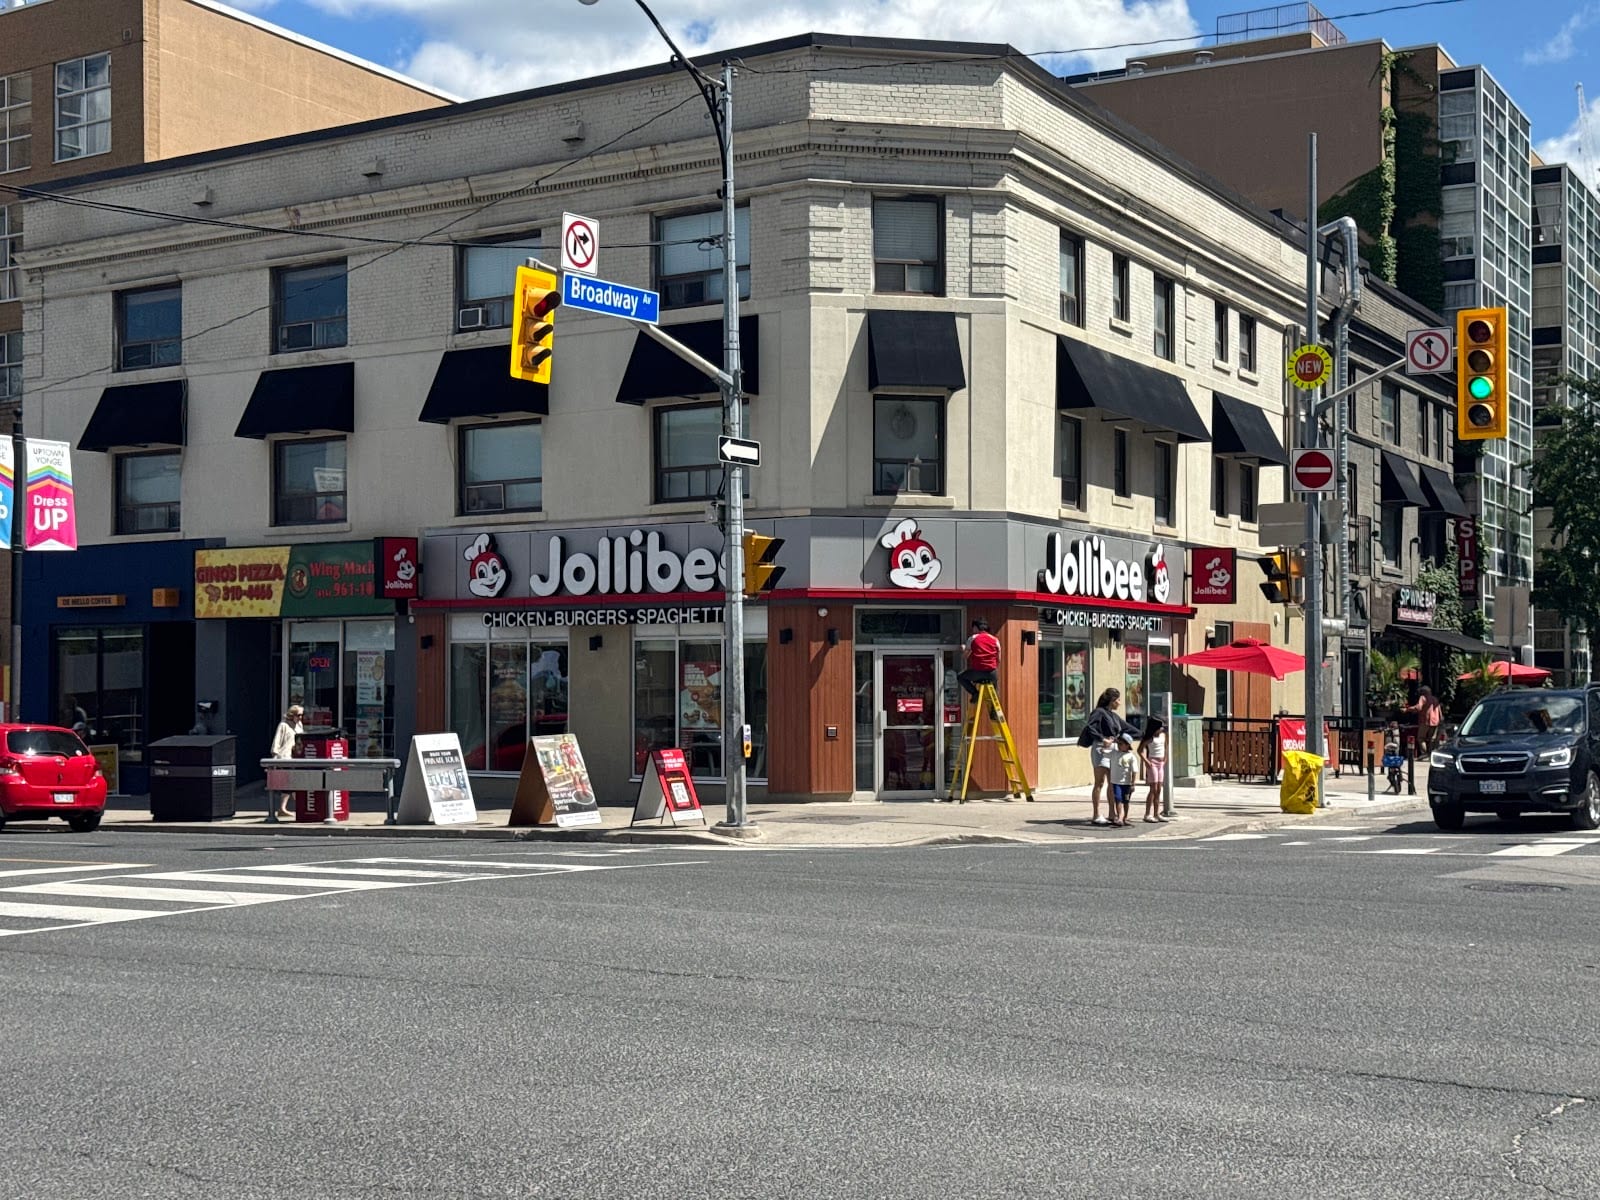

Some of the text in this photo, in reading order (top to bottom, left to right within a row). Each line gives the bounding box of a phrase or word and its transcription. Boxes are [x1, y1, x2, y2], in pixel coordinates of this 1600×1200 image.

[571, 277, 652, 315] Broadway Av
[1296, 360, 1322, 375] NEW
[33, 448, 64, 457] UPTOWN
[36, 457, 62, 466] YONGE
[33, 495, 68, 506] Dress
[34, 507, 68, 531] UP
[1459, 520, 1474, 577] SIP
[239, 563, 284, 582] PIZZA
[310, 561, 340, 579] Wing
[1045, 532, 1142, 601] Jollibee
[385, 580, 413, 589] Jollibee
[1194, 586, 1228, 595] Jollibee
[1410, 589, 1425, 607] WINE
[1425, 591, 1436, 608] BAR
[482, 611, 549, 628] CHICKEN
[555, 609, 628, 626] BURGERS
[1057, 610, 1163, 632] CHICKEN BURGERS SPAGHETTI
[310, 657, 330, 668] OPEN
